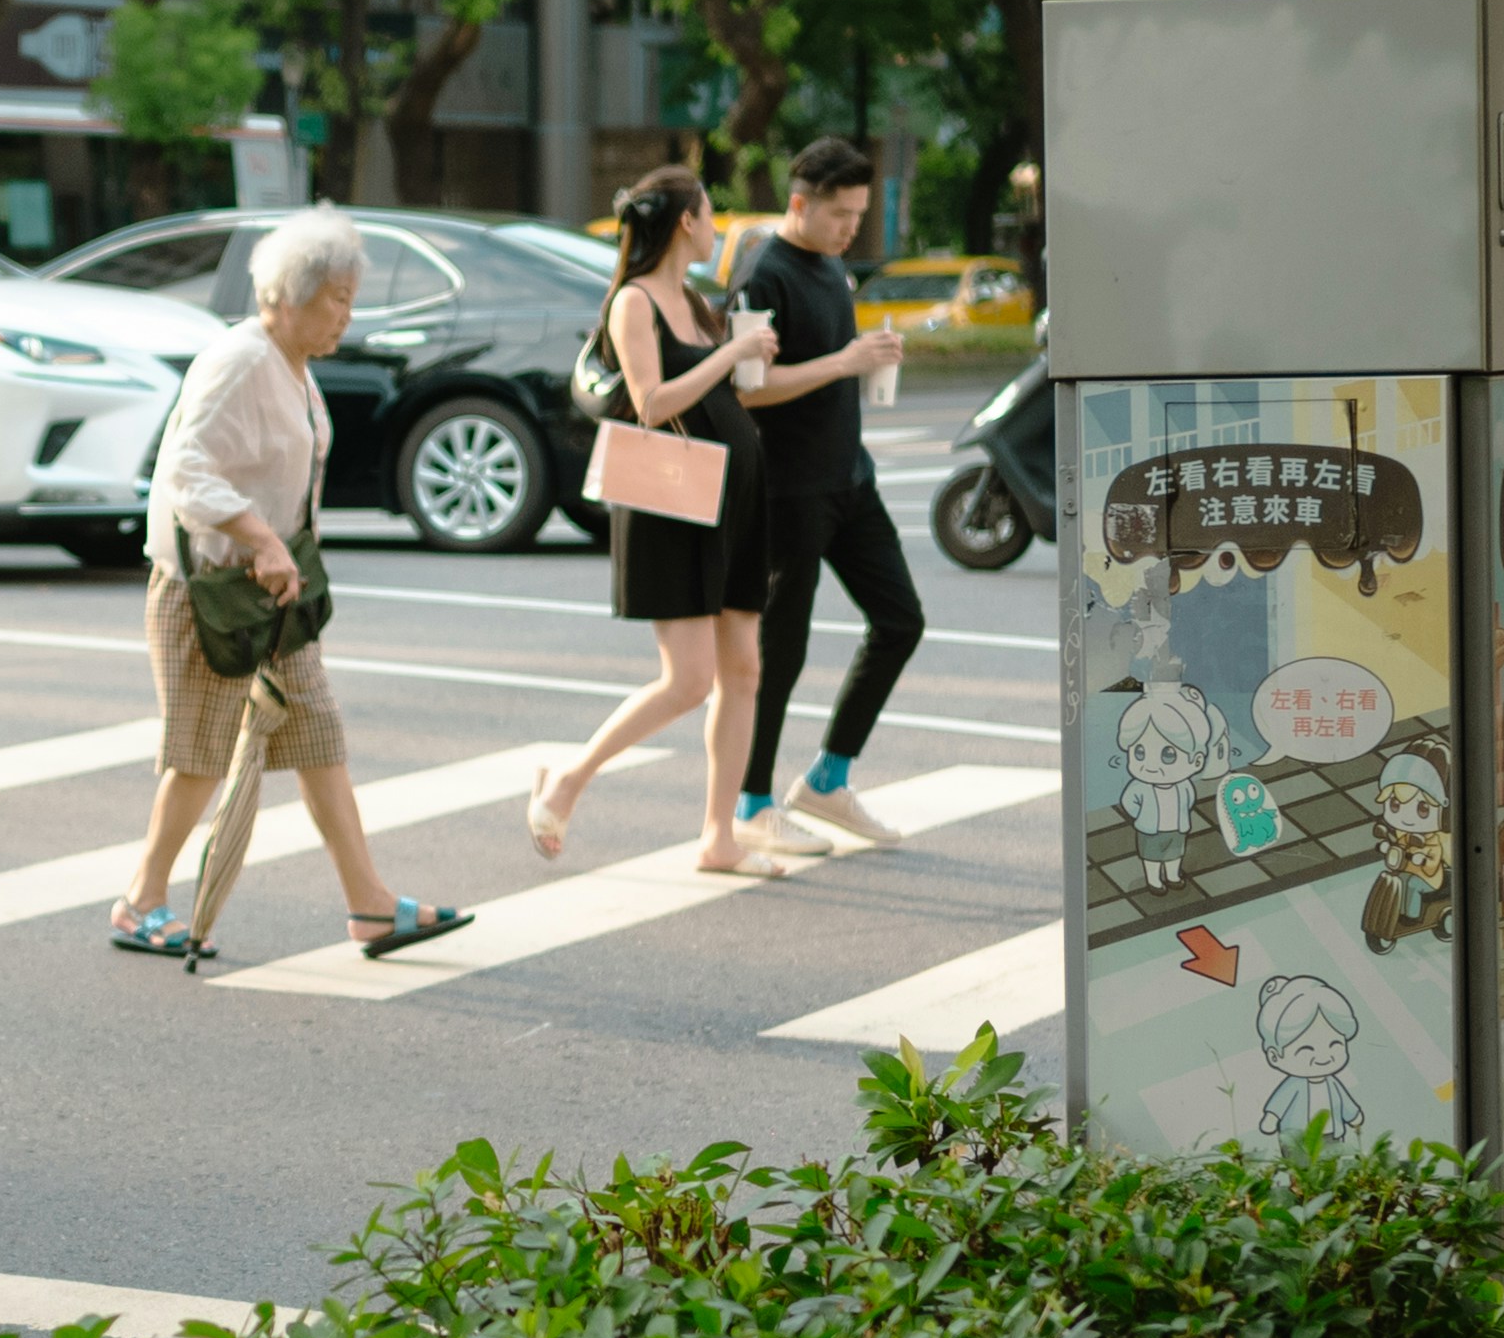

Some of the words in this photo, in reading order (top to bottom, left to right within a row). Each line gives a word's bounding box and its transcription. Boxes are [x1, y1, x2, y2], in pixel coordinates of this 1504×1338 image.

[1145, 456, 1376, 496] 左看右看再左看
[1199, 495, 1323, 527] 注意來車
[1270, 689, 1378, 712] 左看、右看
[1292, 716, 1356, 738] 再左看
